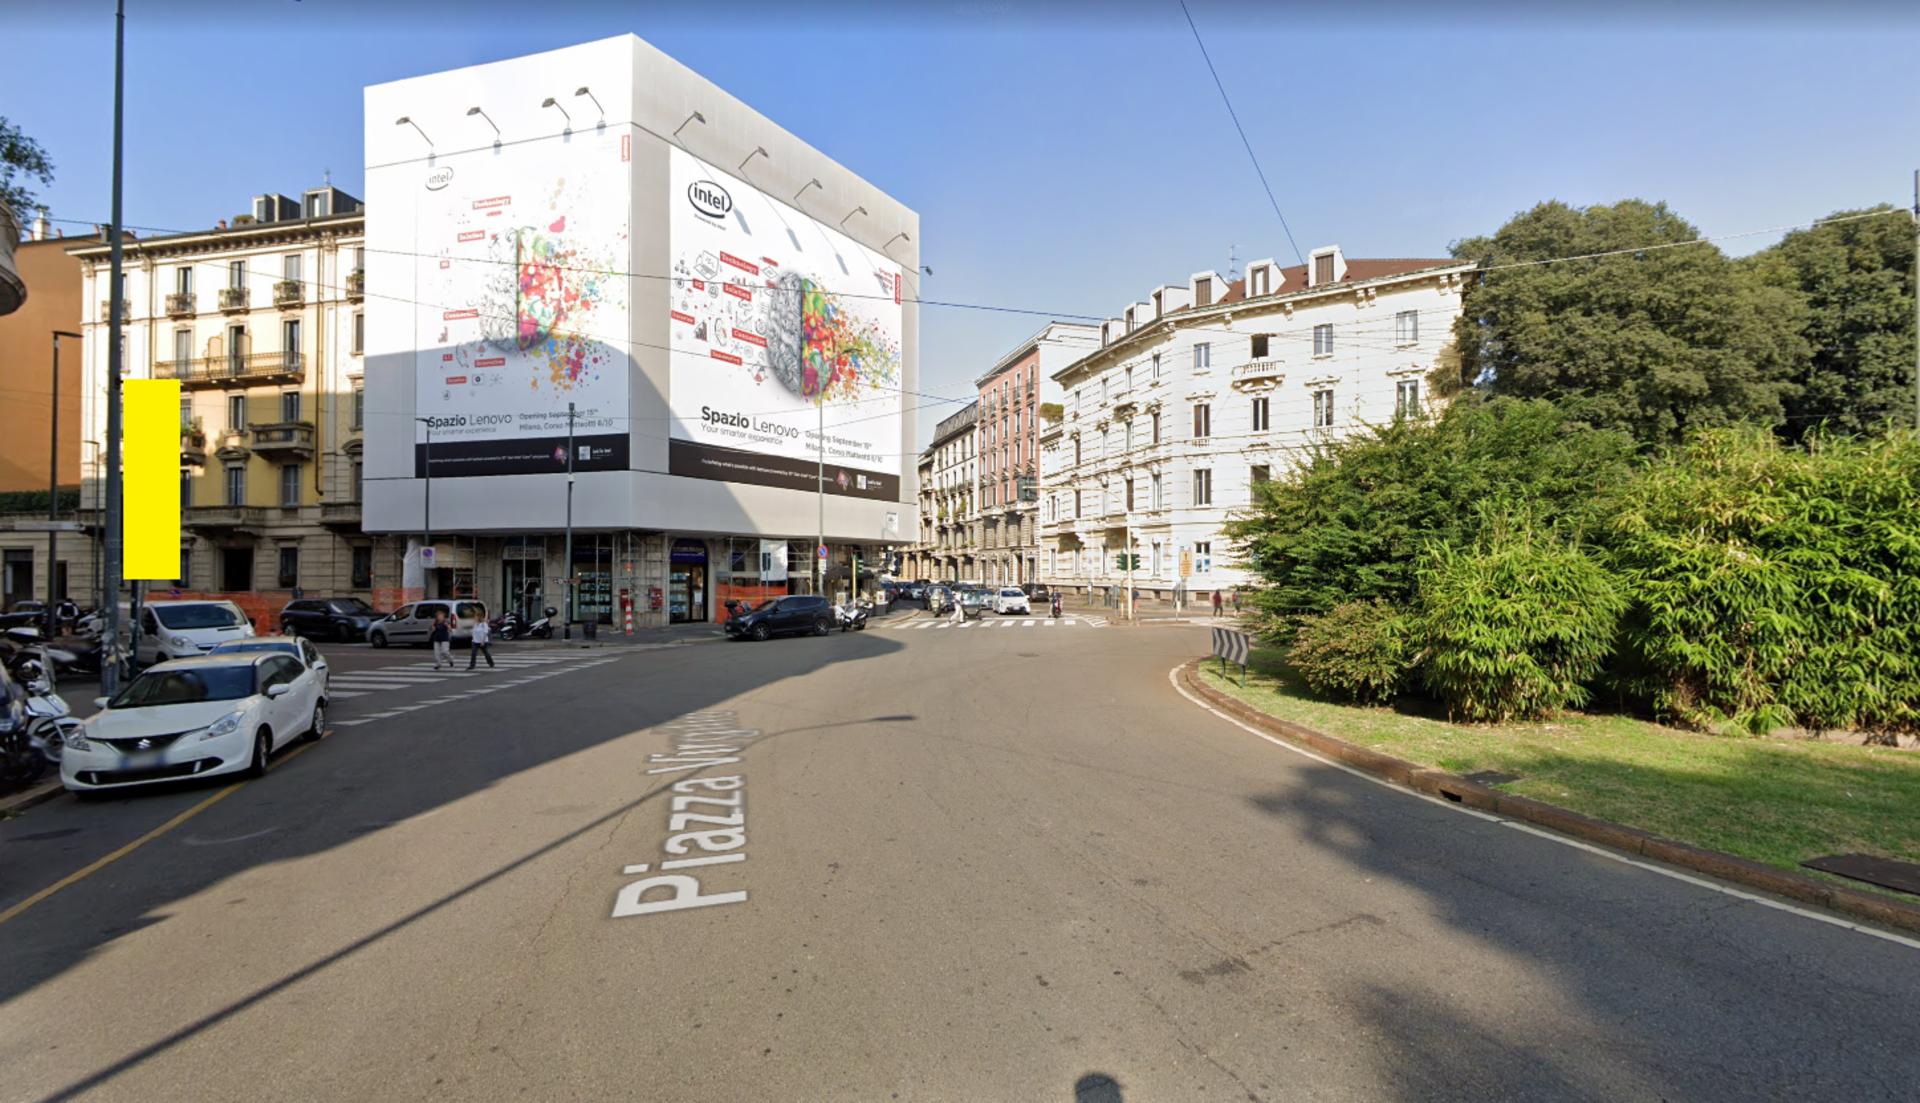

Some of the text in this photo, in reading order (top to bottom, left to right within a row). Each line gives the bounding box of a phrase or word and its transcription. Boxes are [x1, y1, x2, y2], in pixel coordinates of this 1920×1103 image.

[694, 182, 725, 211] intel
[427, 414, 512, 429] Spazio Lenovo
[701, 405, 799, 439] Spazio Lenovo
[701, 422, 718, 433] Your
[720, 427, 747, 438] smarter
